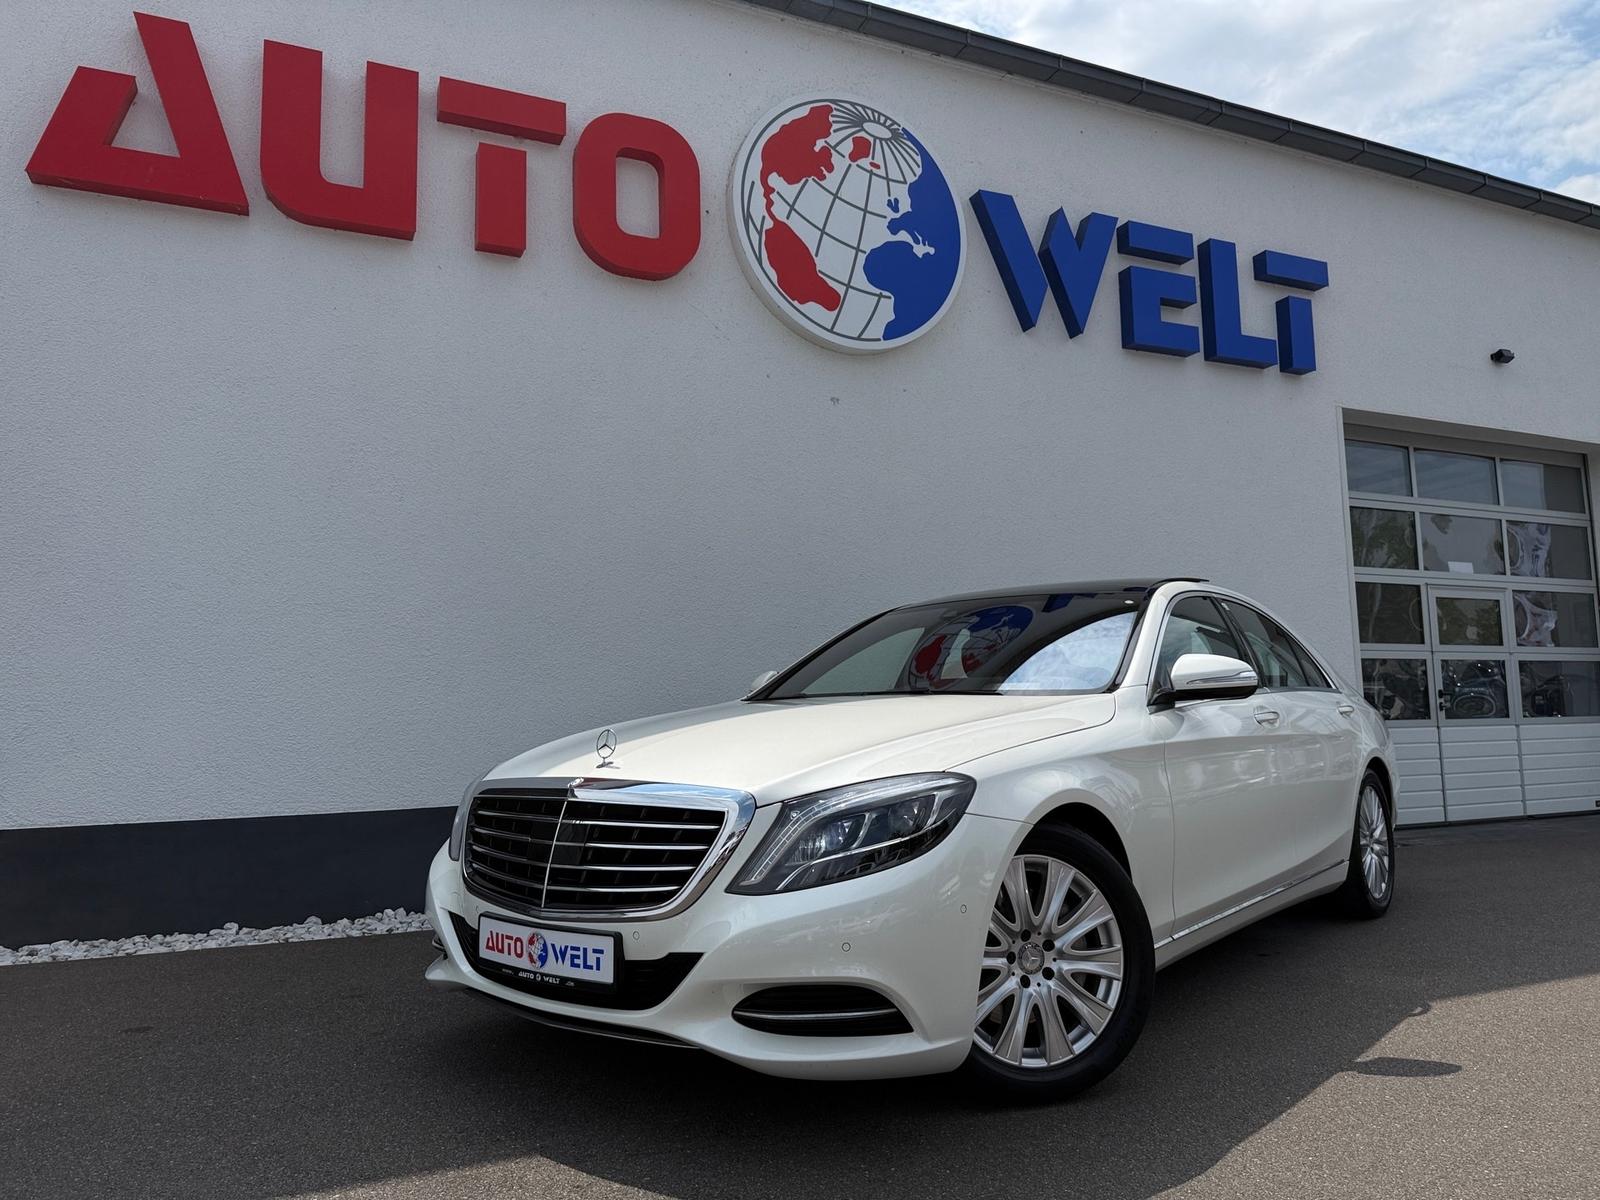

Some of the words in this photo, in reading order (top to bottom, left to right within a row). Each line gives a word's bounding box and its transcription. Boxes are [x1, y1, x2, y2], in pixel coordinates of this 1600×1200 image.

[25, 11, 701, 281] AUTO
[968, 189, 1329, 376] WELT
[485, 930, 524, 958] AUTO
[550, 942, 605, 971] WELT
[518, 970, 535, 979] AUTO
[543, 975, 560, 984] WELT
